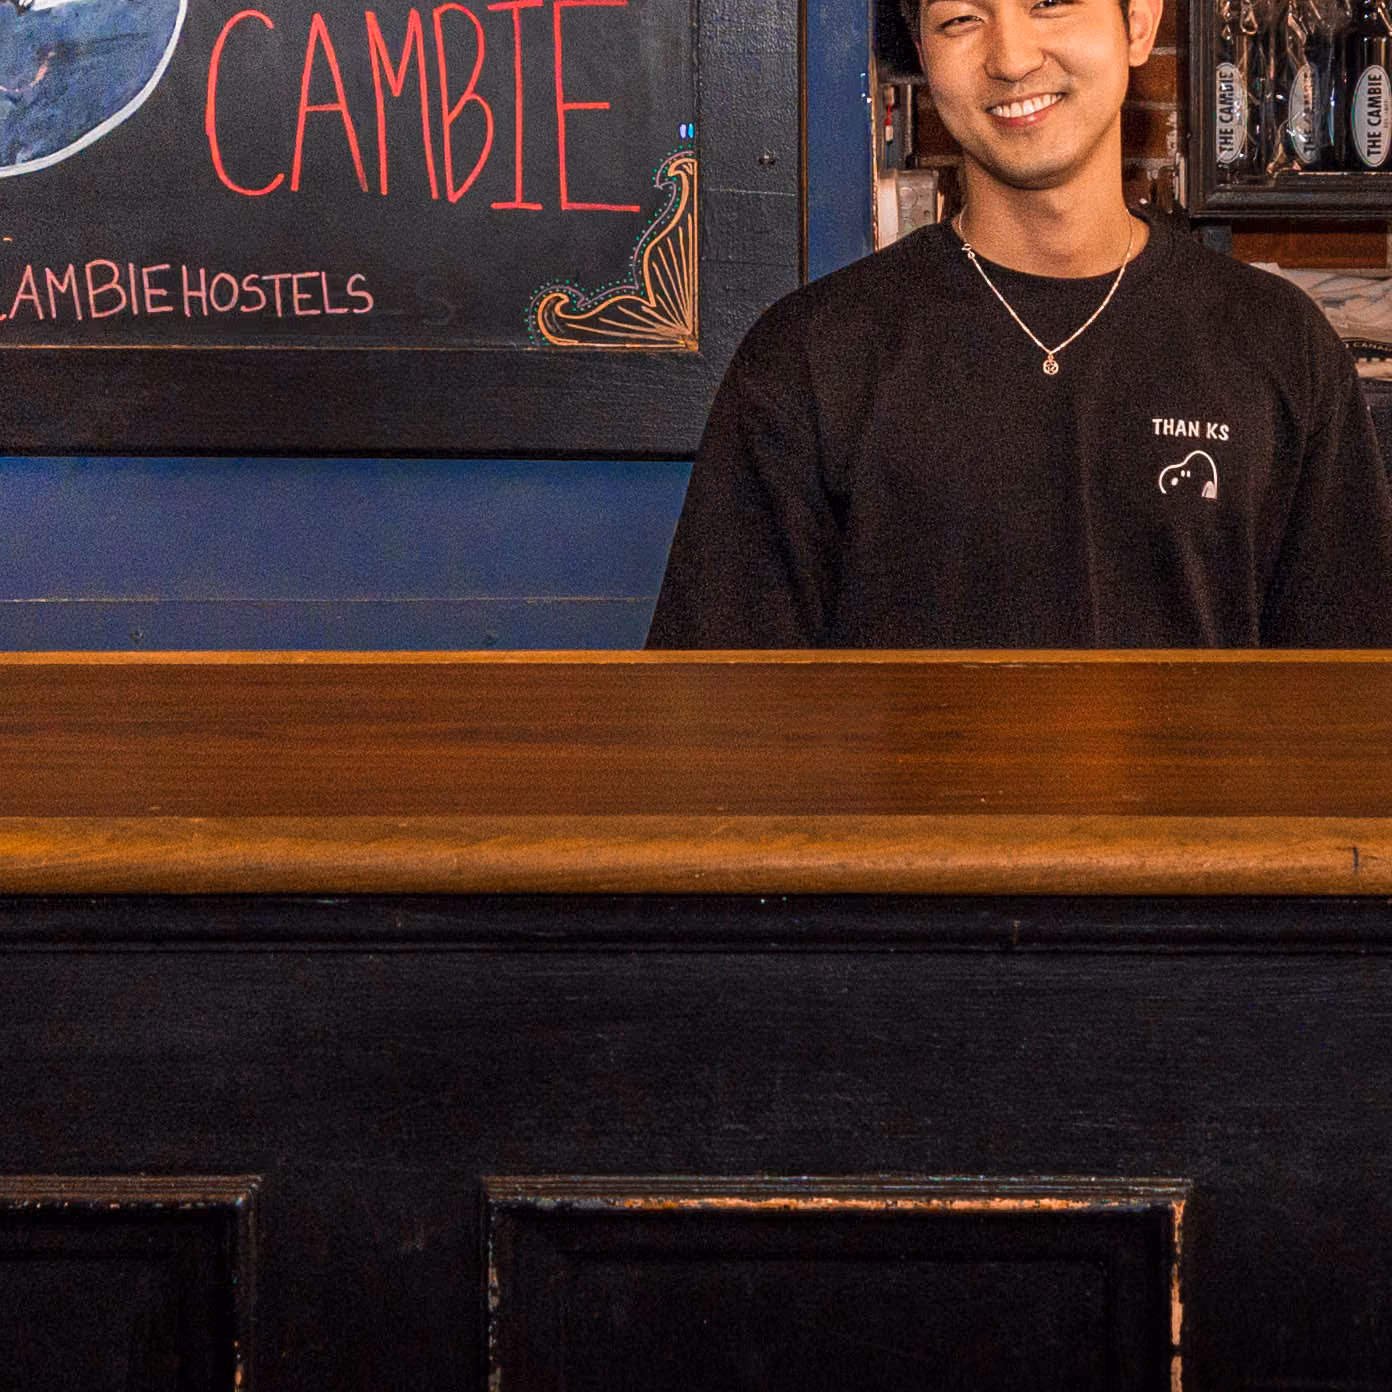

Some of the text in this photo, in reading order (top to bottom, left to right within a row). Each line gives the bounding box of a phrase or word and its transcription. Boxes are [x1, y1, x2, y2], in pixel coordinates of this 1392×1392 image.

[205, 0, 642, 211] CAMBIE
[1219, 127, 1234, 153] THE
[1367, 73, 1382, 157] THE CAMBIE
